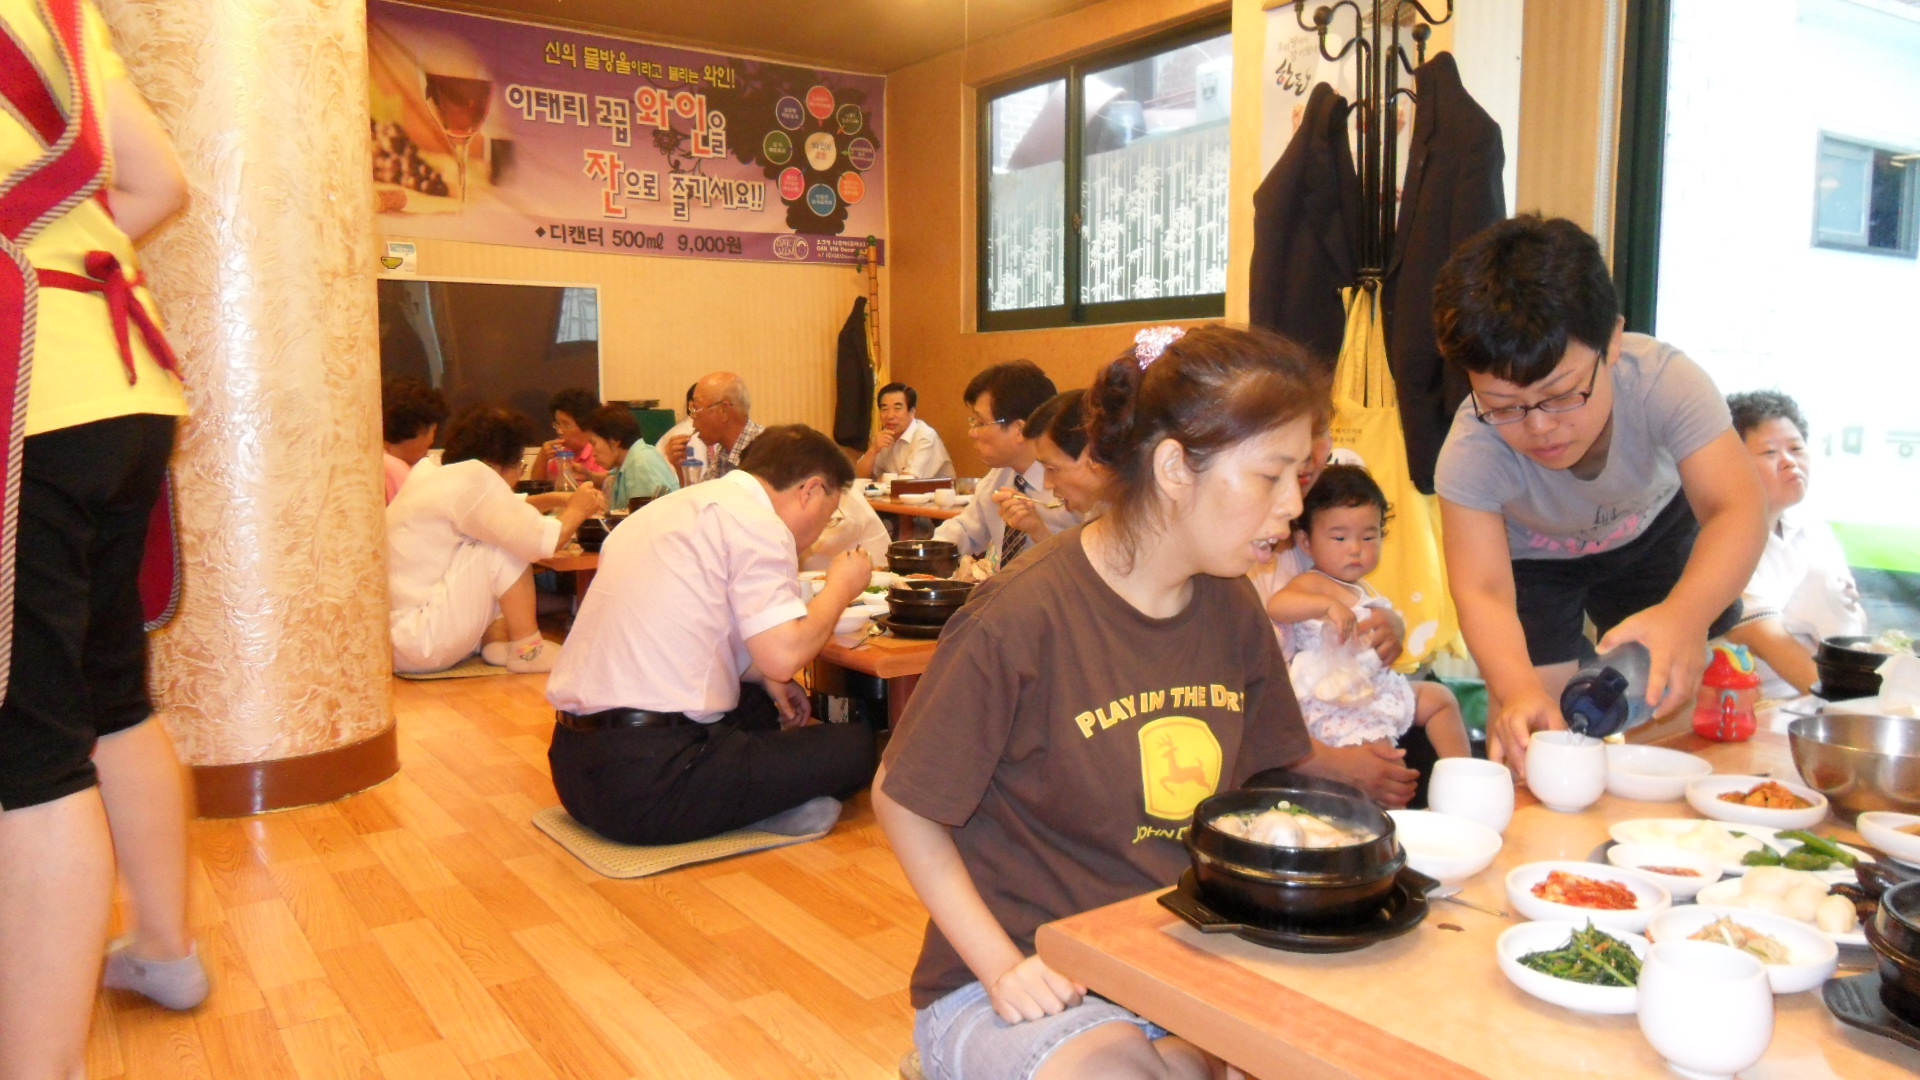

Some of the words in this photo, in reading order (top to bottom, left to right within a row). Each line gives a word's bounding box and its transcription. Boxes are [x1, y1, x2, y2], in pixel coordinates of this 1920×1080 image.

[545, 41, 577, 68] 신의
[584, 47, 662, 79] 물방울이라고
[668, 66, 699, 84] 불리는
[703, 64, 736, 89] 와인!
[505, 84, 589, 126] 이태리
[595, 95, 631, 147] 고급
[634, 86, 727, 158] 와인을
[583, 149, 660, 218] 잔으로
[669, 173, 765, 221] 즐기세요!!
[550, 224, 604, 246] 디캔터
[677, 233, 743, 255] 9,000원
[1075, 695, 1137, 739] PLAY
[1140, 690, 1165, 713] IN
[1170, 686, 1206, 708] THE
[1132, 825, 1175, 844] JOHN
